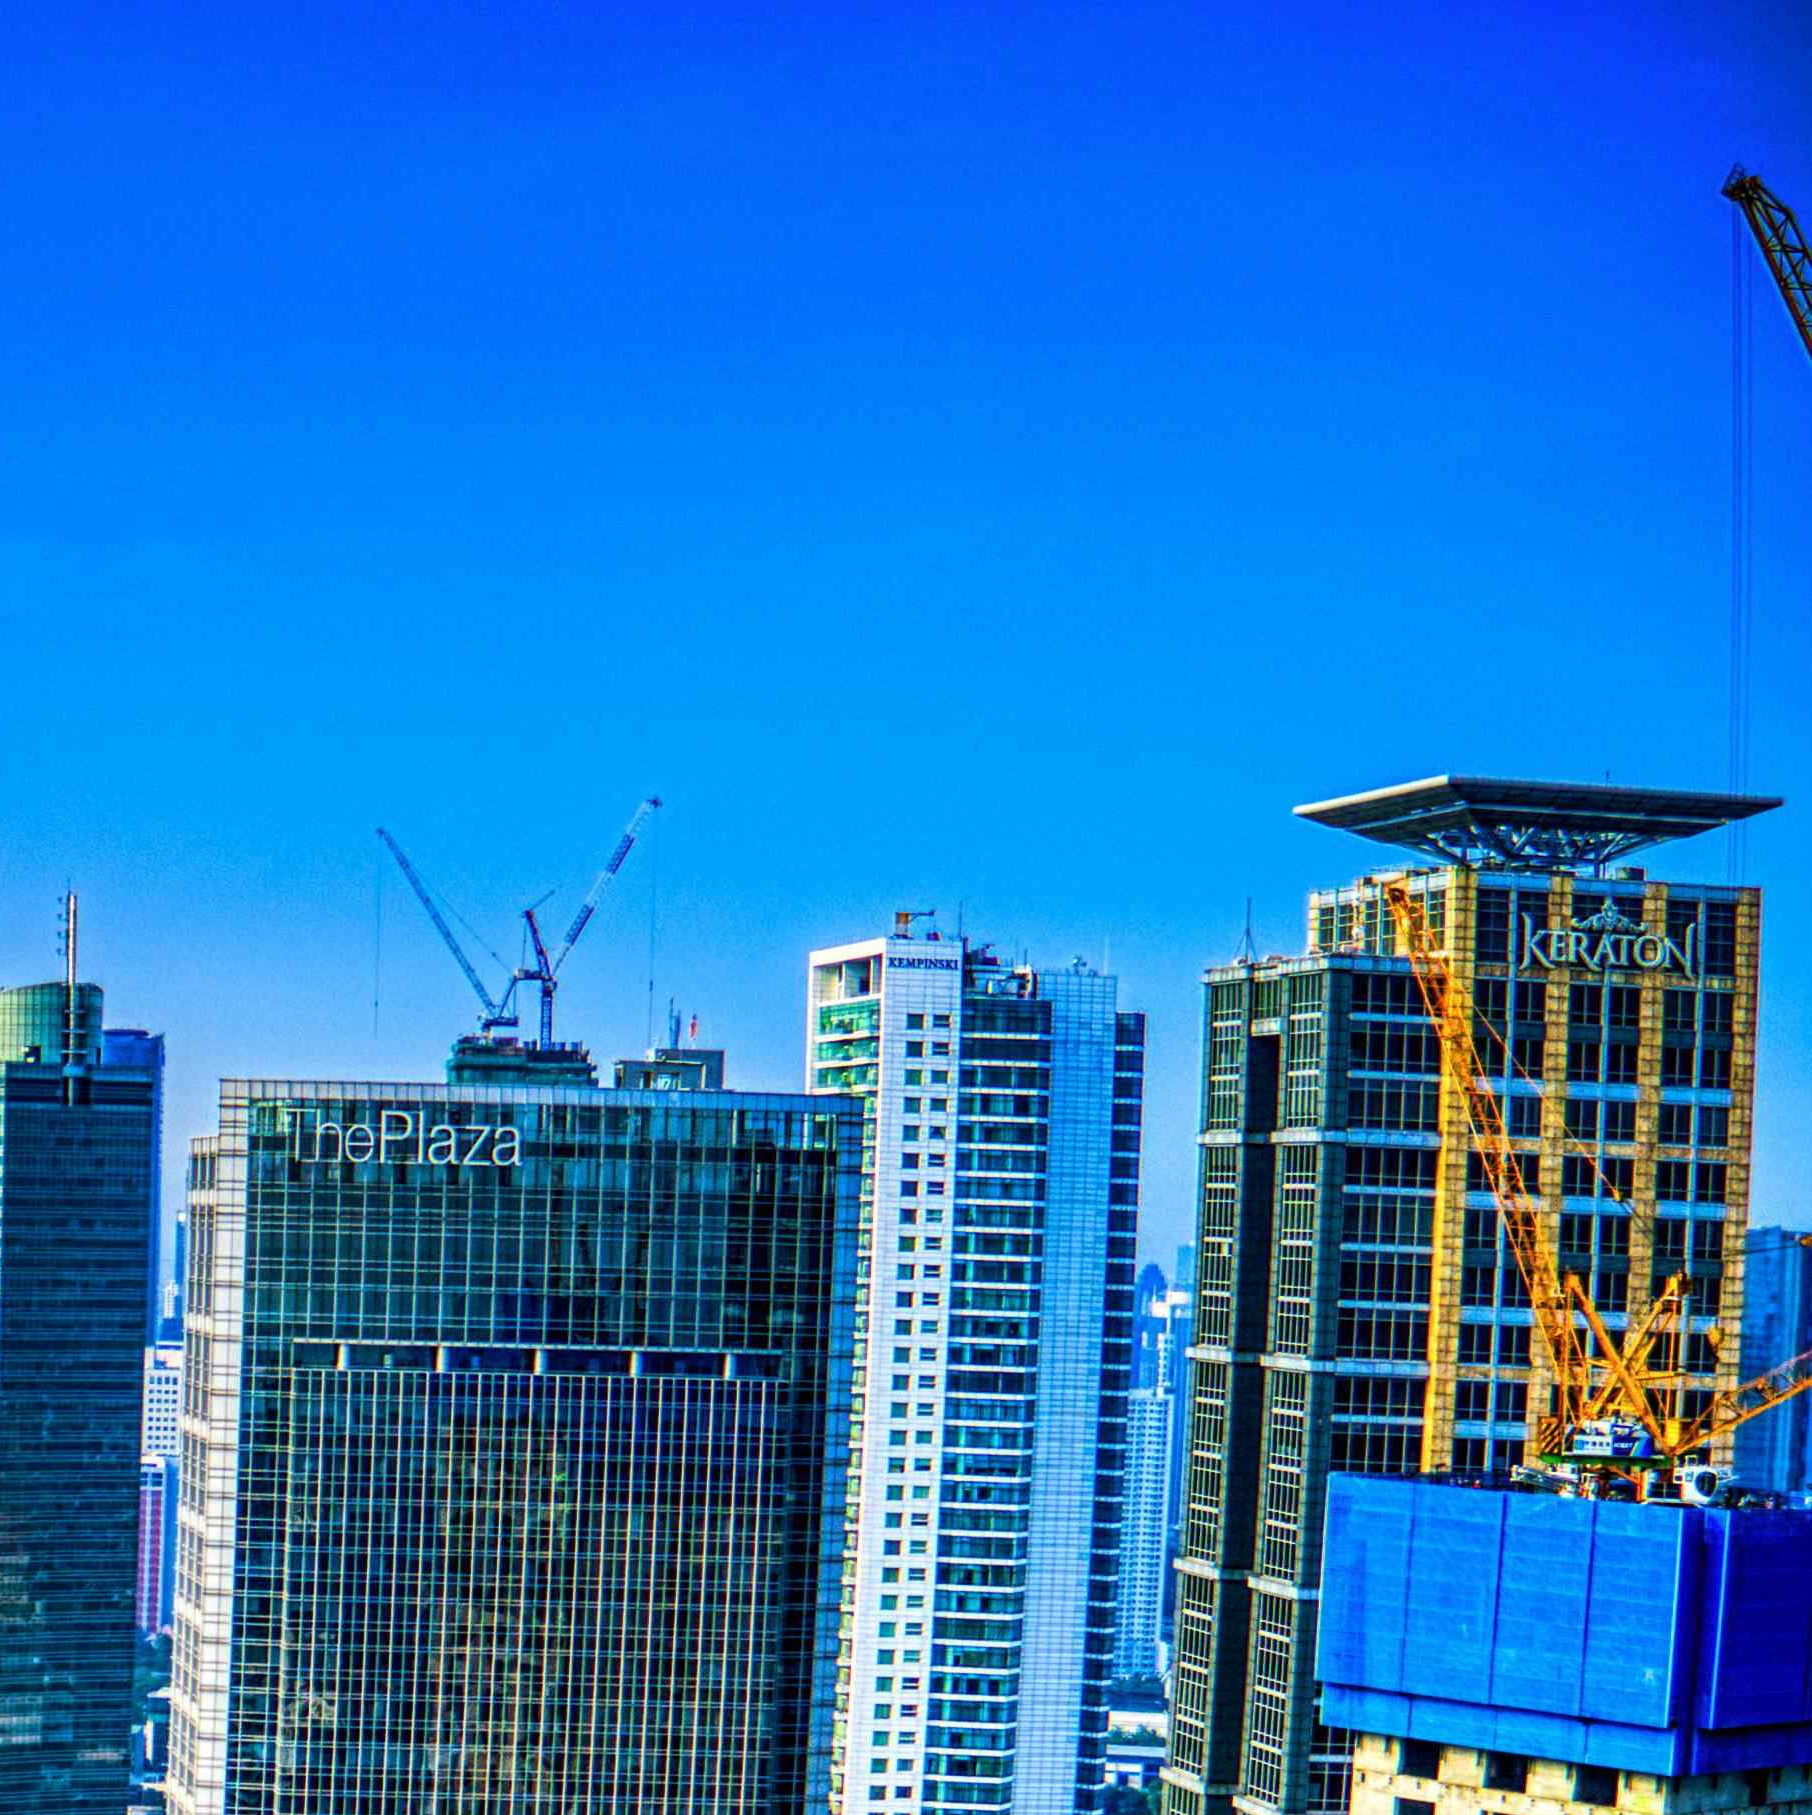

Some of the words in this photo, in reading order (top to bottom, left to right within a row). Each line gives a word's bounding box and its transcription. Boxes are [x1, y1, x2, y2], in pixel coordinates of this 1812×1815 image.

[889, 957, 958, 970] KEMPINSKI
[1519, 912, 1696, 978] KERATON
[281, 1107, 523, 1166] ThePlaza
